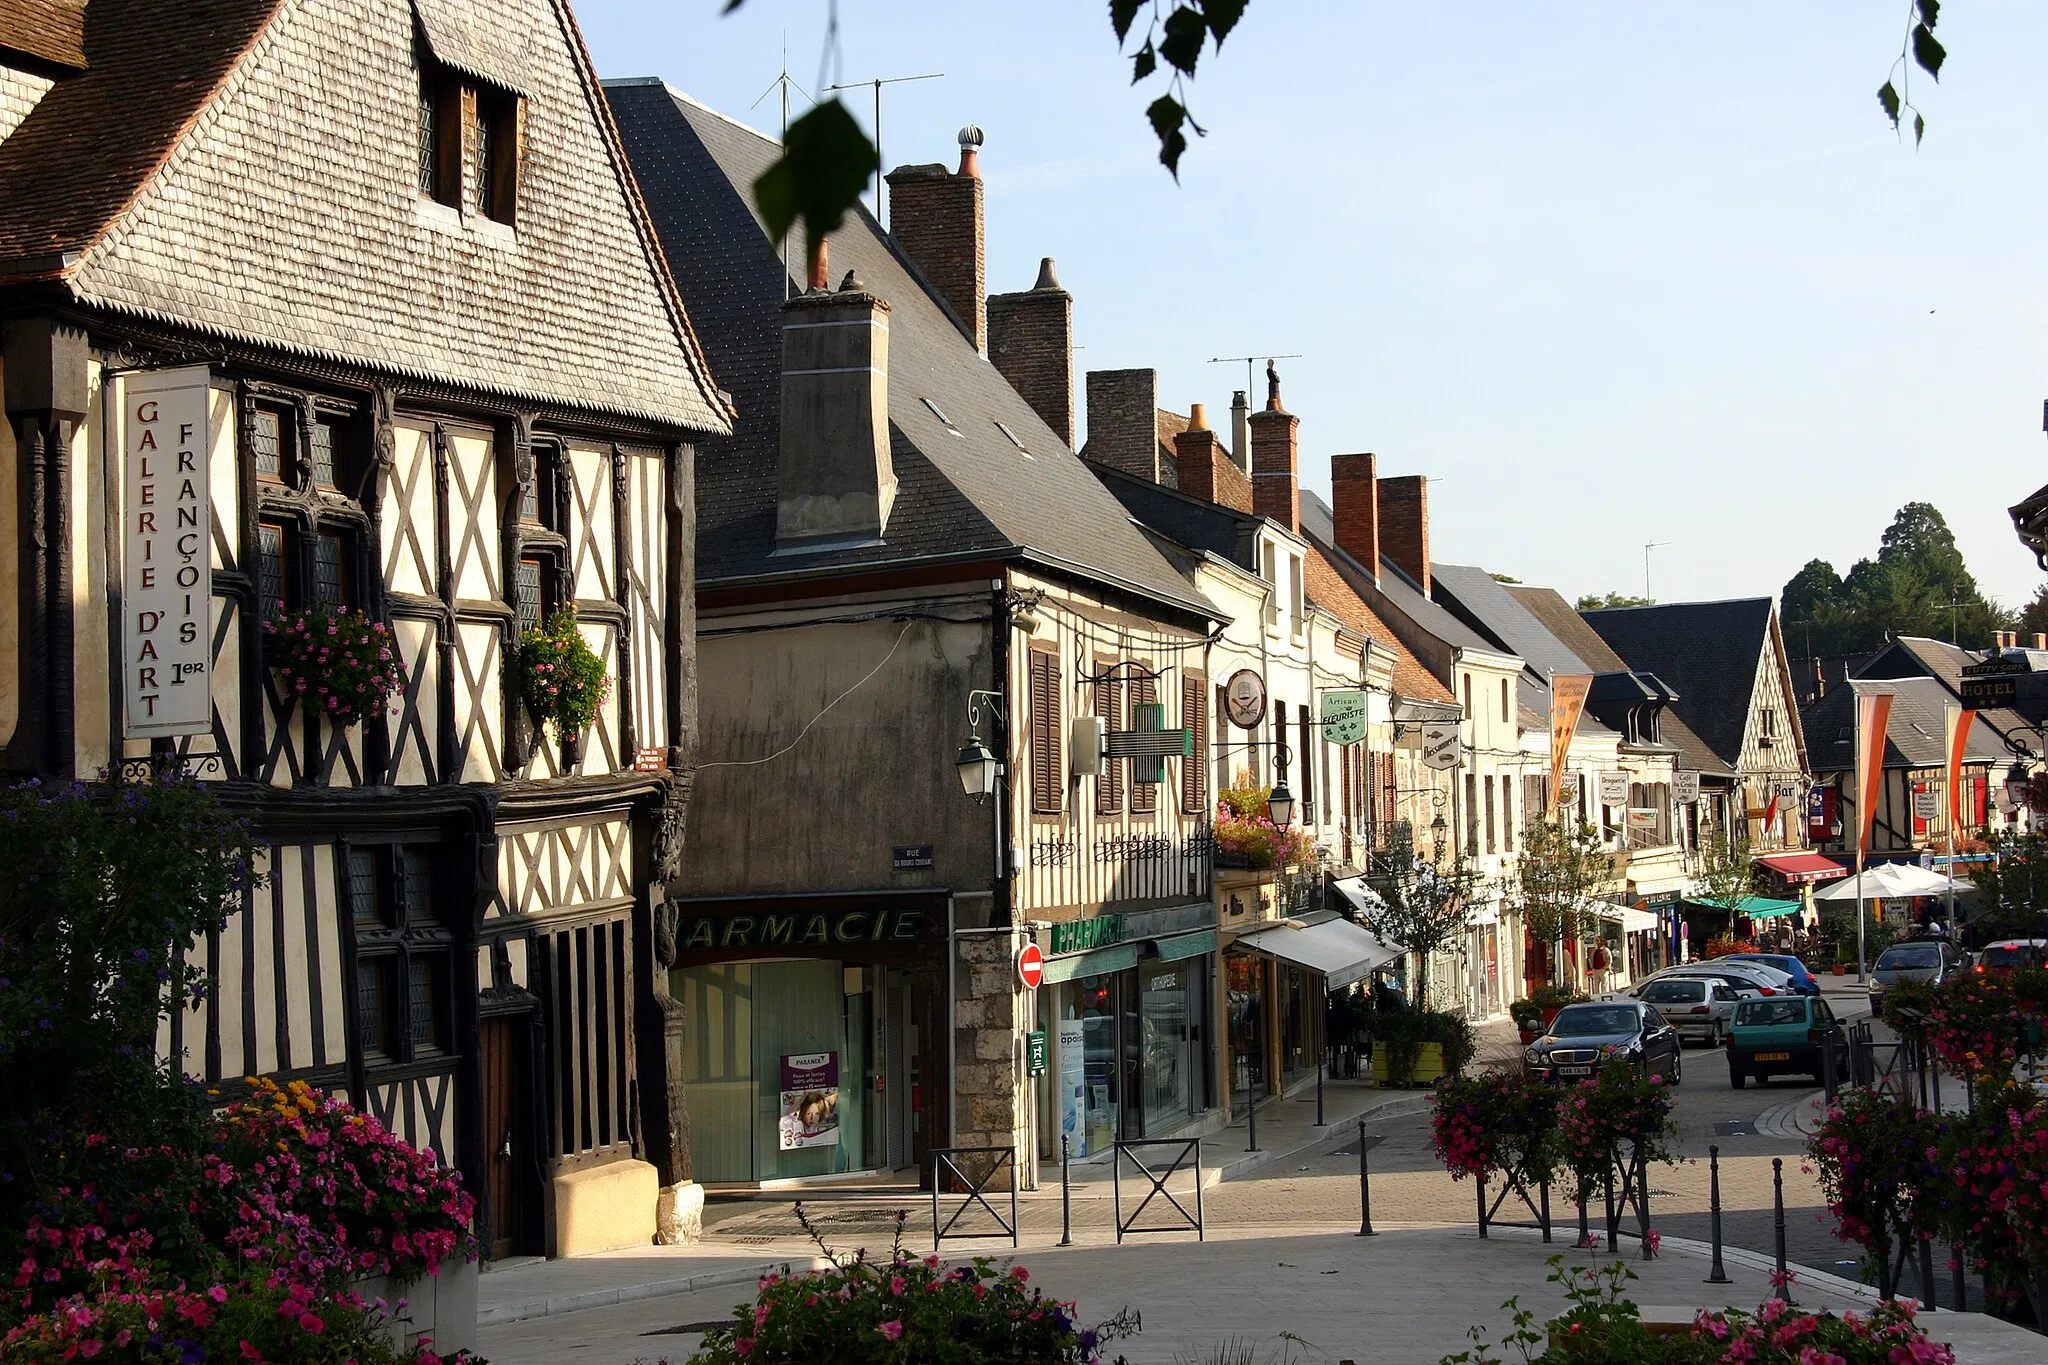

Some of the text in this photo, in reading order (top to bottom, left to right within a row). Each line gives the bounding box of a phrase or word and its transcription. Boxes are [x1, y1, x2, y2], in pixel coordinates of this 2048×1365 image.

[176, 423, 200, 645] FRANÇOIS
[137, 400, 166, 717] GALERIE D'ART
[1966, 663, 2026, 674] CUTTY SARK
[1962, 682, 2015, 697] HOTEL
[1323, 708, 1365, 724] FLEURISTE
[1601, 776, 1627, 785] Droguerie
[1774, 783, 1795, 797] Bar
[906, 849, 920, 857] RUE
[679, 909, 927, 949] ARMACIE
[1055, 913, 1128, 953] PHARMACIE
[796, 1056, 823, 1067] PARANIX
